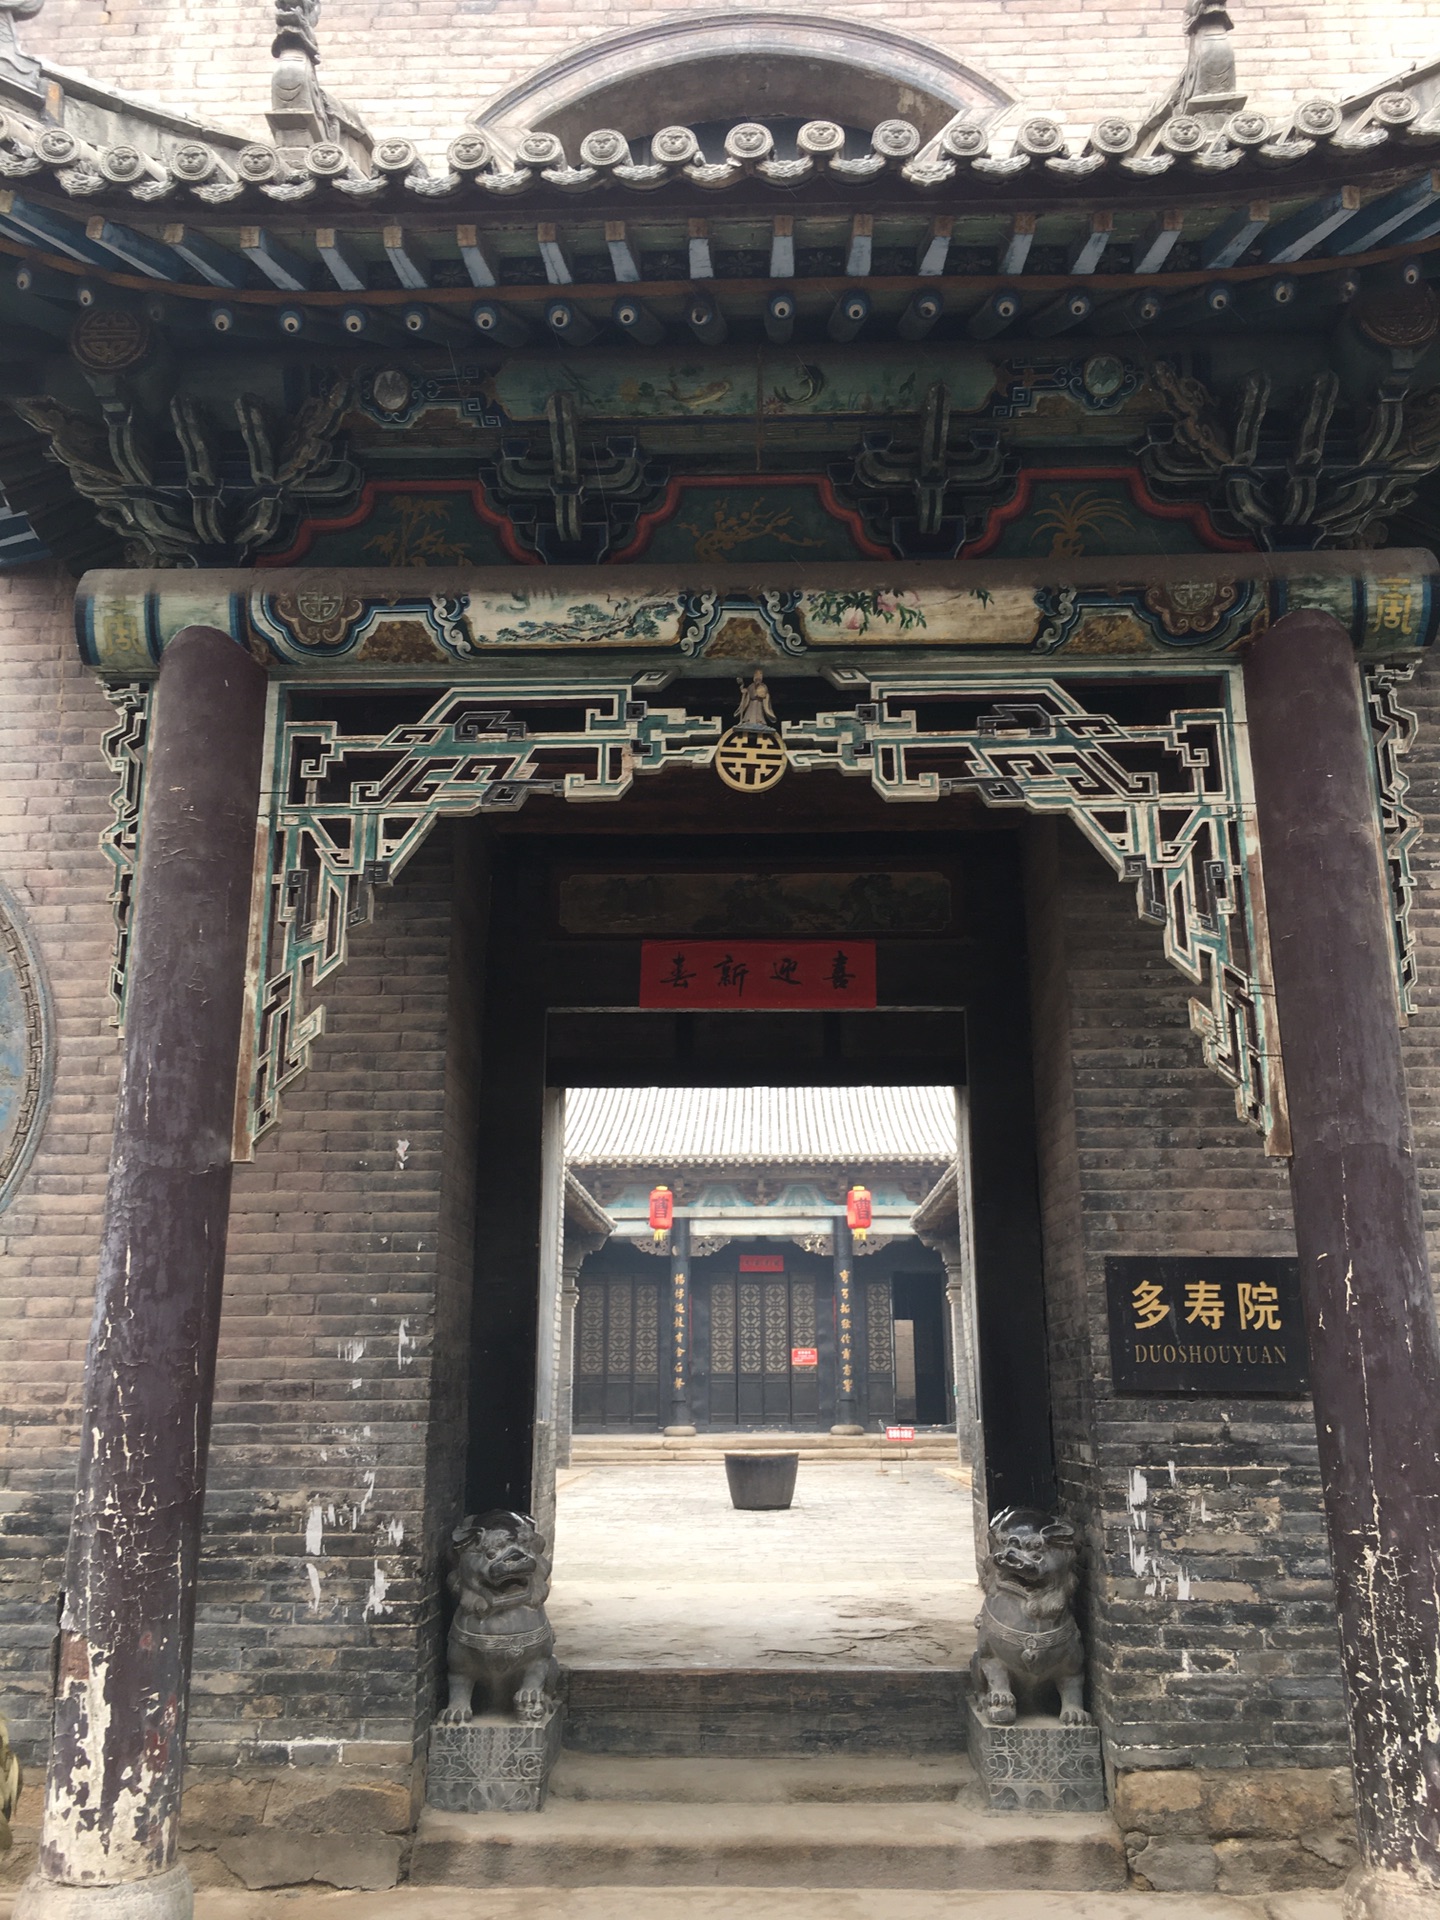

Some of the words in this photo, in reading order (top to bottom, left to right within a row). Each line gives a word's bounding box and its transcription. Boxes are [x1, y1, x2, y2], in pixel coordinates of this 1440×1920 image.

[1131, 1279, 1283, 1331] 多寿院
[1135, 1344, 1287, 1365] DUOSHOUYUAN
